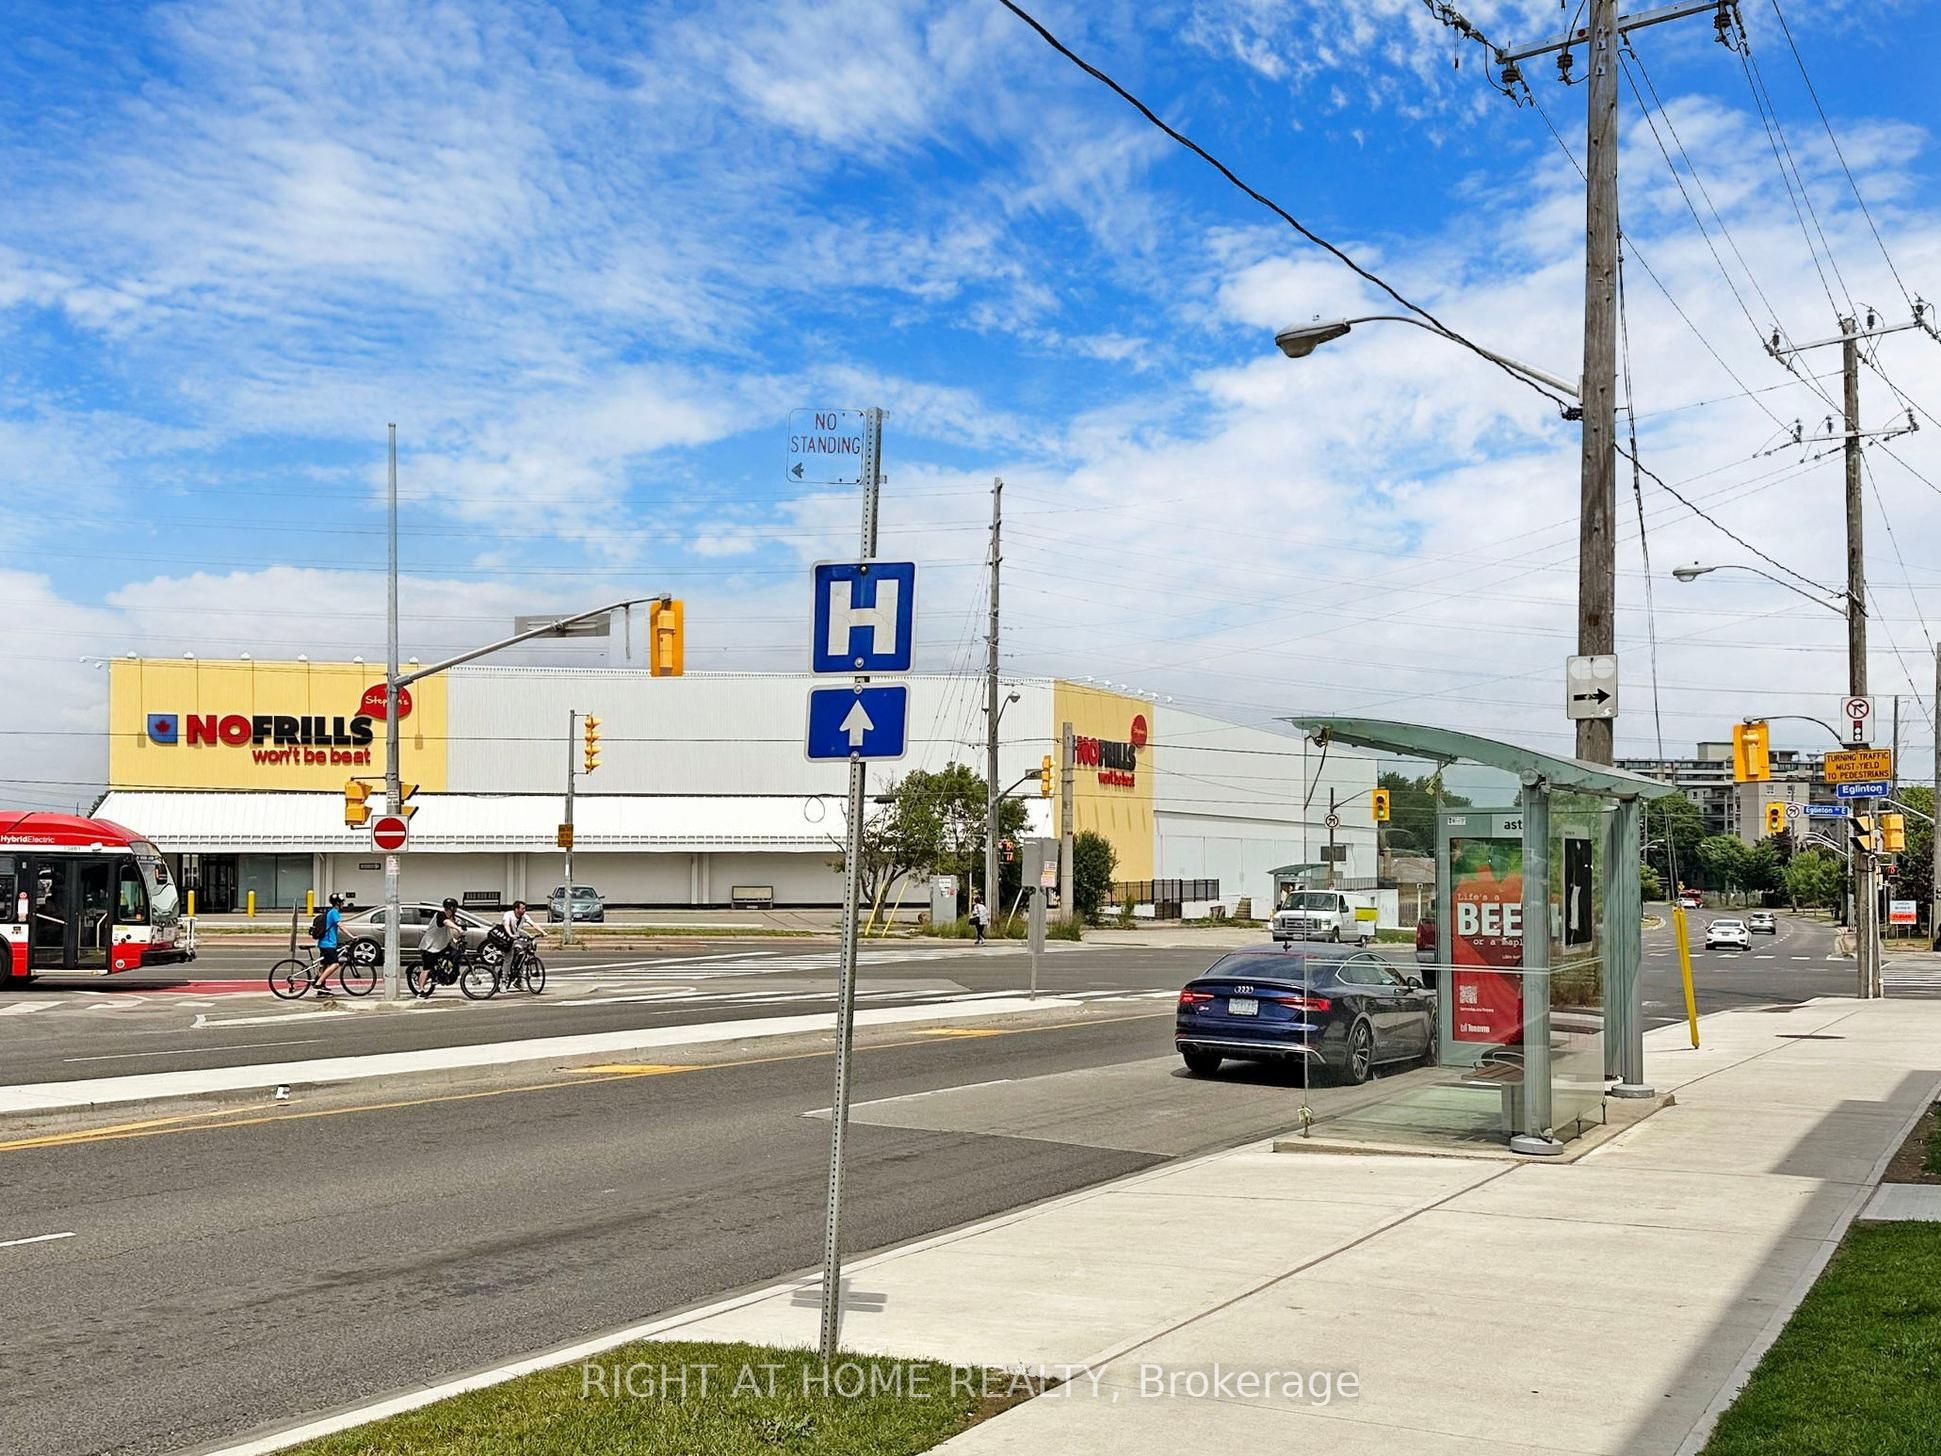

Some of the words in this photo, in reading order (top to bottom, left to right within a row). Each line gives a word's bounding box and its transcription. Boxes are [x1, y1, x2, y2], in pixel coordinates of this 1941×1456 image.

[815, 413, 837, 431] NO
[791, 436, 861, 455] STANDING
[827, 579, 899, 655] H
[252, 748, 300, 764] won't
[304, 747, 327, 764] be
[330, 748, 371, 765] beat
[1826, 753, 1856, 762] TURNING
[1859, 752, 1889, 761] TRAFFIC
[1859, 761, 1880, 769] YIELD
[1828, 772, 1836, 780] TO
[1840, 769, 1889, 779] PEDESTRIANS
[1842, 784, 1882, 795] Eglinton
[1458, 893, 1488, 901] Life's
